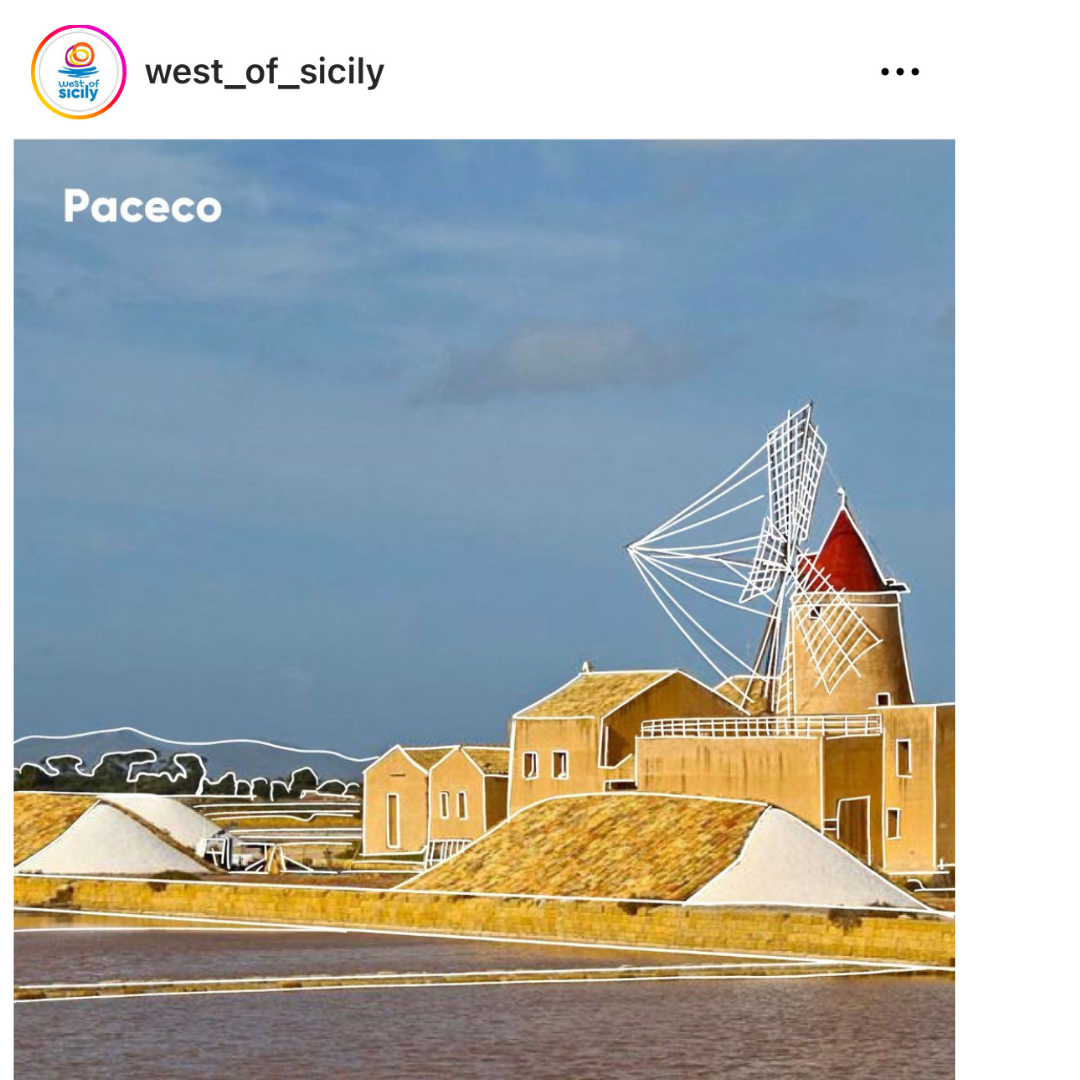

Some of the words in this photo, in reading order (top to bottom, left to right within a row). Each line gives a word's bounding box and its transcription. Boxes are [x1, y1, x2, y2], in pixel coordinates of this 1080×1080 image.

[144, 56, 385, 91] west_of_sicily
[58, 80, 84, 88] west
[88, 79, 100, 88] of
[58, 84, 99, 102] sicily
